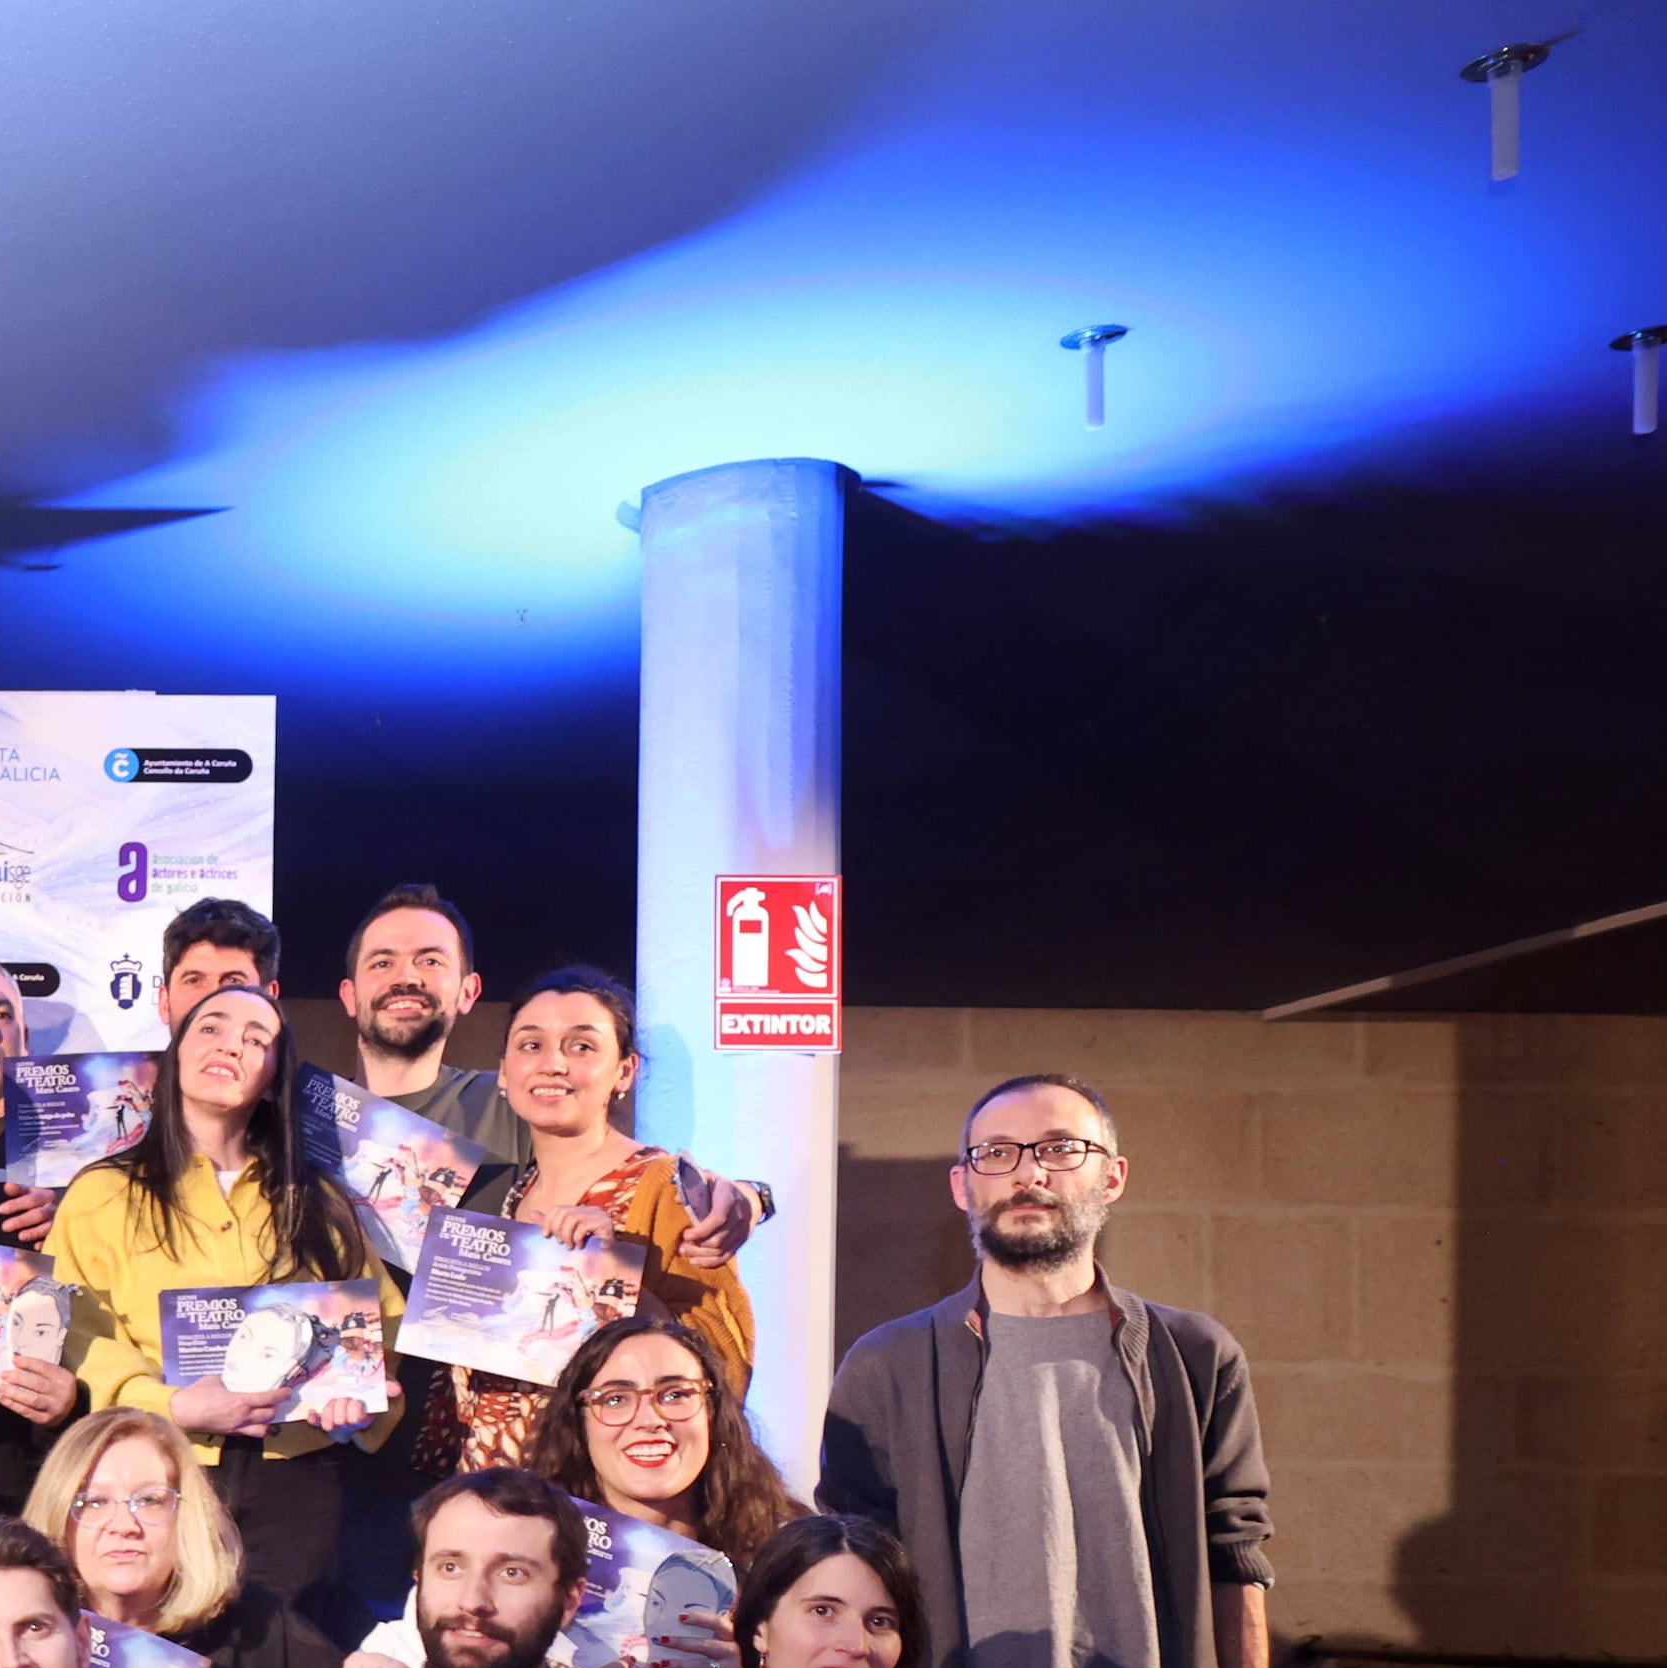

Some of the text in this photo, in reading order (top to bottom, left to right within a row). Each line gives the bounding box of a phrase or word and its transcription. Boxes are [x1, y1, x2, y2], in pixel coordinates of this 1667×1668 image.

[207, 855, 219, 866] de
[152, 869, 238, 880] actores e actrices
[152, 882, 198, 895] de galicia
[721, 1013, 832, 1035] EXTINTOR
[441, 1219, 507, 1243] PREMIOS
[451, 1234, 511, 1256] TEATRO
[176, 1298, 237, 1313] PREMIOS
[187, 1309, 246, 1323] TEATRO
